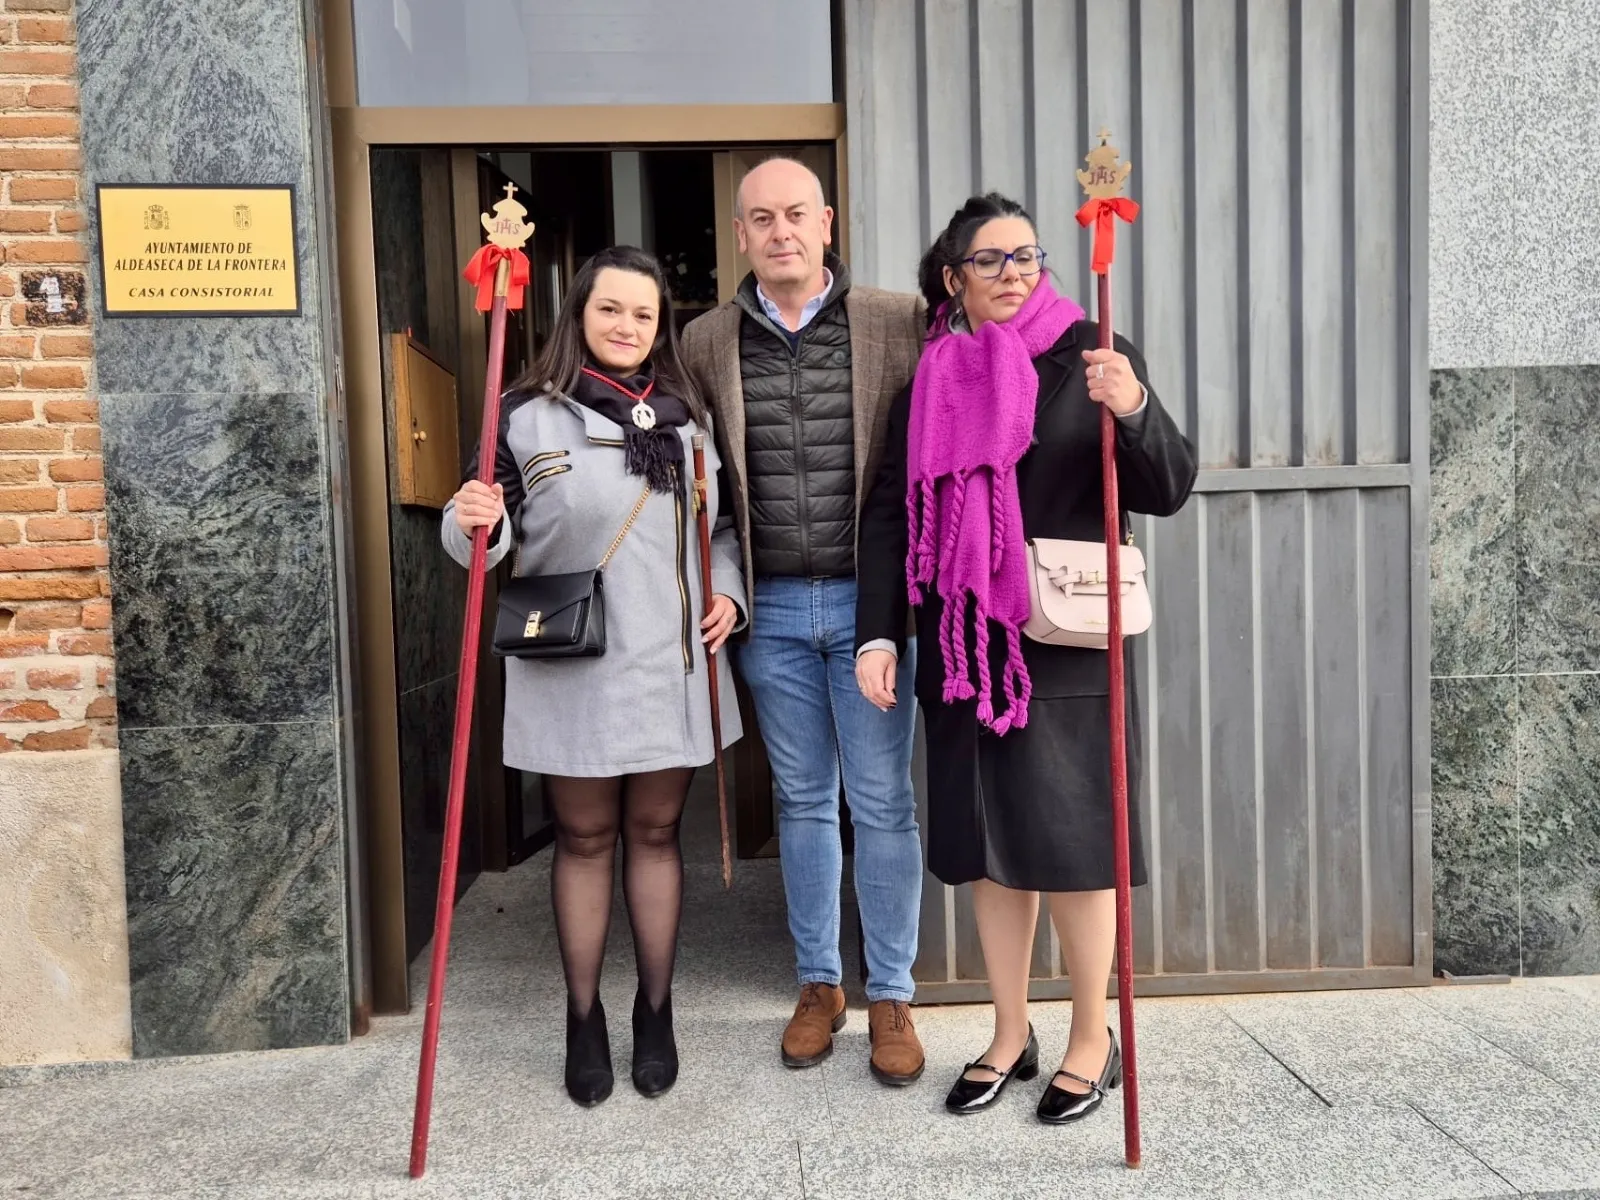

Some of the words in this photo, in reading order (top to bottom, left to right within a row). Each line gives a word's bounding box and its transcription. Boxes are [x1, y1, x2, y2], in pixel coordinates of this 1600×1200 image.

[145, 242, 234, 254] AYUNTAMIENTO
[238, 242, 253, 254] DE
[113, 258, 184, 271] ALDEASECA
[187, 258, 204, 271] DE
[207, 258, 221, 271] LA
[224, 258, 287, 271] FRONTERA
[128, 287, 165, 298] CASA
[170, 287, 275, 298] CONSISTORIAL
